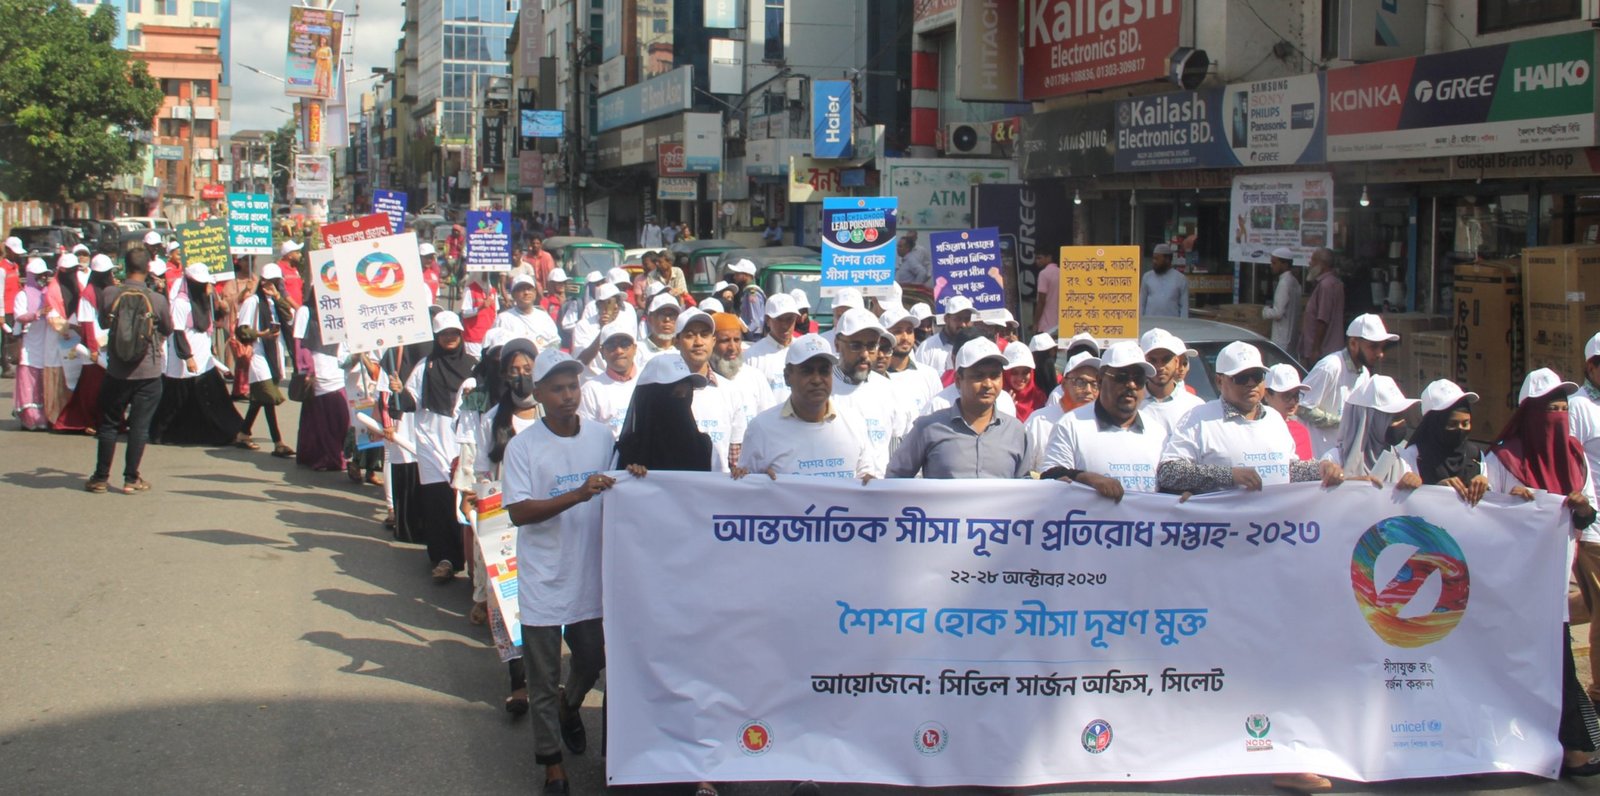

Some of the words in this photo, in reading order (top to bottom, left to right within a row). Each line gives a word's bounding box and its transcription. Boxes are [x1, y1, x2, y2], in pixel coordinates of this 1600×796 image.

[525, 0, 538, 64] OTEL
[1051, 35, 1117, 69] Electronics
[1119, 28, 1142, 55] BD.
[1513, 59, 1590, 92] HAIKO
[1251, 80, 1289, 93] SAMSUNG
[1436, 74, 1495, 101] GREE
[1251, 94, 1284, 106] SONY
[1330, 83, 1402, 112] KONKA
[1131, 92, 1206, 127] Kailash
[1251, 107, 1280, 119] PHILIPS
[825, 95, 840, 143] Haier
[1250, 120, 1287, 132] Panasonic
[1058, 129, 1107, 151] SAMSUNG
[1119, 125, 1187, 149] Electronics
[1190, 121, 1214, 144] BD.
[1251, 133, 1278, 142] HITACHI
[1258, 152, 1280, 161] GREE
[1457, 151, 1494, 169] Global
[1499, 151, 1536, 168] Brand
[1539, 148, 1574, 169] Shop
[929, 190, 966, 206] ATM
[832, 221, 848, 231] LEAD
[1019, 188, 1036, 265] GREE
[936, 242, 966, 252] প্রতিরোধ
[832, 254, 861, 265] শৈশব
[863, 254, 886, 265] হোক
[826, 267, 849, 280] সীসা
[851, 269, 891, 283] দূষণমুক্ত
[969, 266, 985, 277] সীসা
[952, 283, 969, 295] দূষণ
[970, 282, 985, 292] মুক্ত
[1086, 277, 1093, 286] ও
[319, 294, 341, 311] সীস
[975, 293, 1001, 303] পরিবার
[358, 302, 399, 317] সীসাযুক্ত
[401, 300, 415, 311] রং
[1061, 306, 1082, 318] সঠিক
[323, 313, 345, 330] নীর
[361, 317, 386, 331] বর্জন
[389, 314, 415, 327] করুন
[797, 459, 824, 470] শৈশব
[825, 457, 845, 467] হোক
[1243, 452, 1267, 462] শৈশব
[1108, 462, 1131, 472] শৈশব
[1132, 463, 1151, 472] হোক
[555, 474, 579, 485] শৈশব
[713, 504, 888, 545] আন্তর্জাতিক
[895, 507, 960, 545] সীসা
[966, 518, 1033, 558] দূষণ
[1041, 509, 1155, 551] প্রতিরোধ
[1160, 520, 1239, 552] সপ্তাহ-
[1246, 521, 1320, 546] ২০২৩
[950, 569, 999, 586] ২২-২৮
[1003, 568, 1064, 588] অক্টোবর
[1067, 572, 1107, 587] ২০২৩
[836, 600, 927, 637] শৈশব
[934, 607, 1006, 638] হোক
[1014, 600, 1077, 638] সীসা
[1084, 608, 1146, 649] দূষণ
[1154, 606, 1208, 646] মুক্ত
[1384, 658, 1417, 676] সীসাযুক্ত
[1419, 662, 1435, 674] রং
[811, 673, 932, 698] আয়োজনে:
[939, 669, 1010, 696] সিভিল
[1016, 670, 1077, 697] সার্জন
[1082, 671, 1154, 697] অফিস,
[1160, 667, 1225, 694] সিলেট
[1385, 675, 1403, 691] বর্জন
[1405, 679, 1435, 690] করুন
[1391, 720, 1426, 733] unicef
